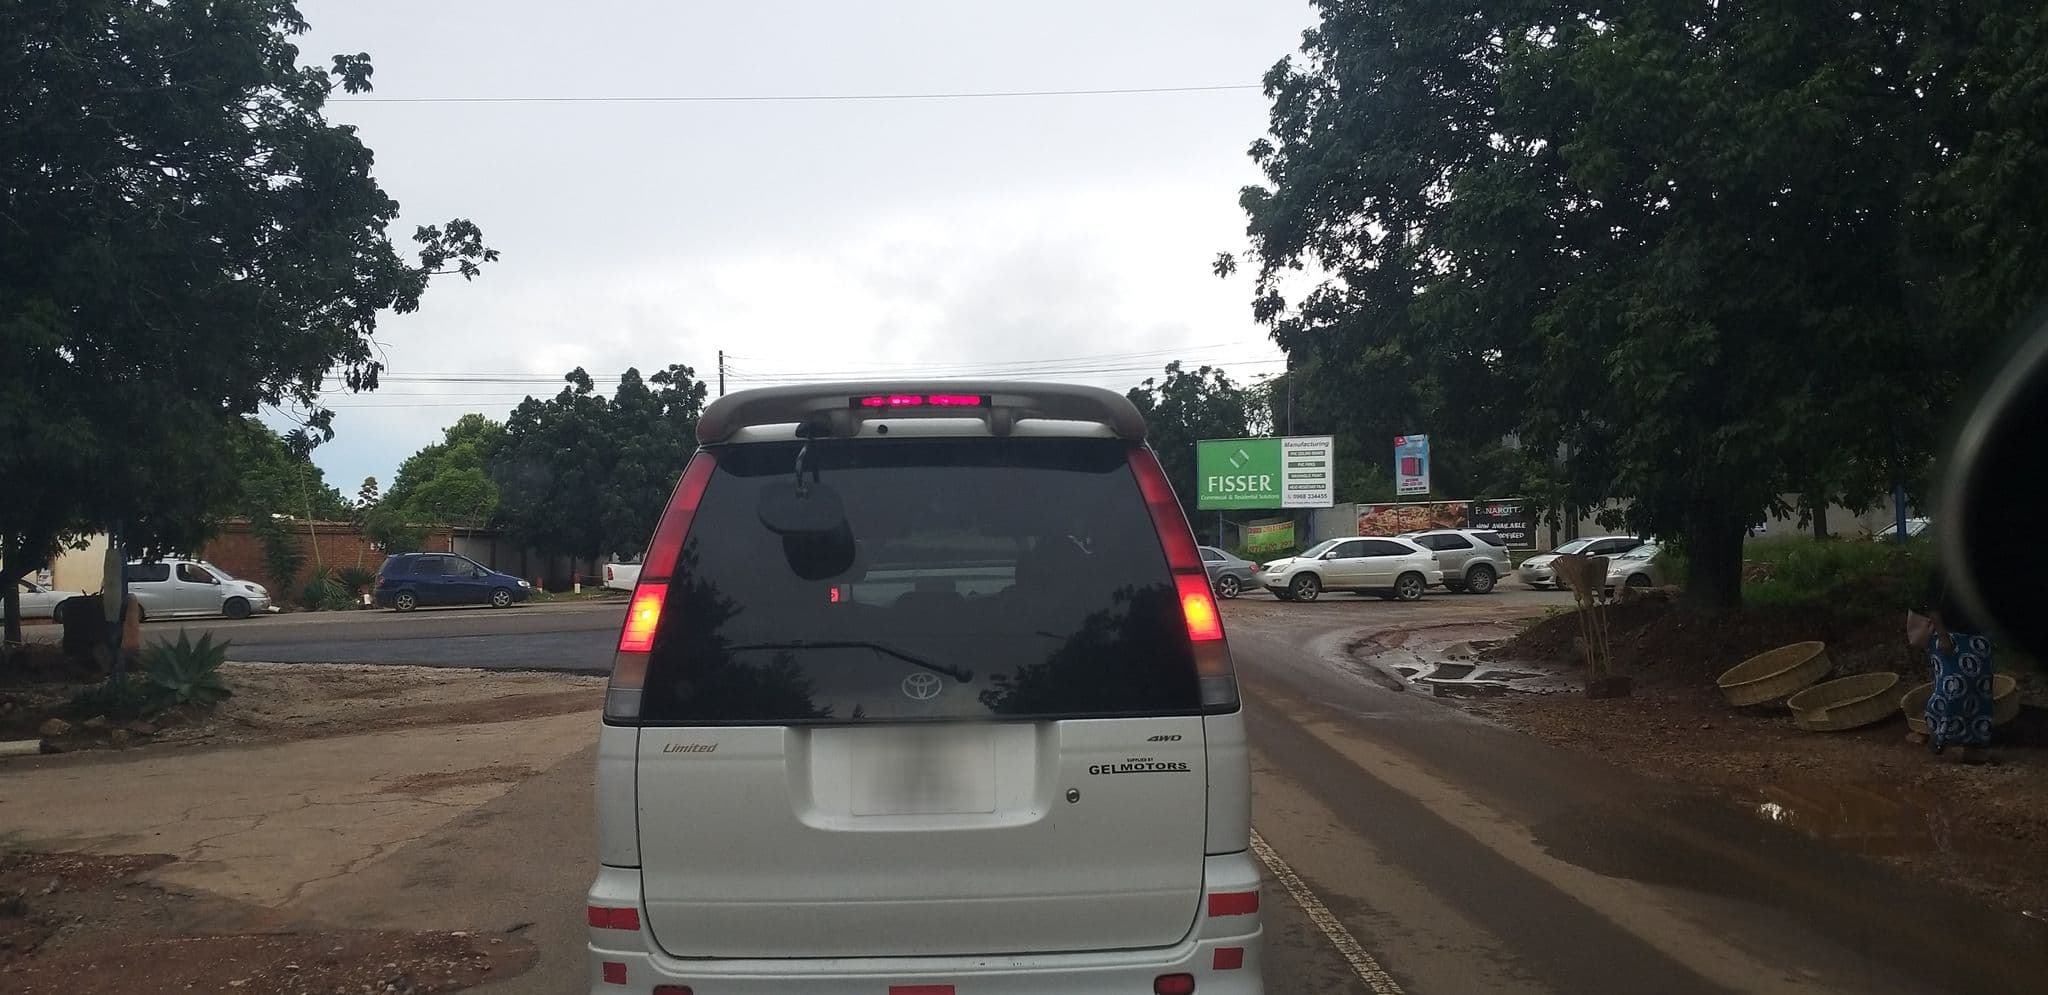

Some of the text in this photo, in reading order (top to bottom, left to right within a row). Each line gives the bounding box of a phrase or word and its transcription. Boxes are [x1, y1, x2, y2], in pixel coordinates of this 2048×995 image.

[1208, 475, 1272, 492] FISSER
[1146, 734, 1182, 742] 4WD
[662, 742, 718, 753] Limited
